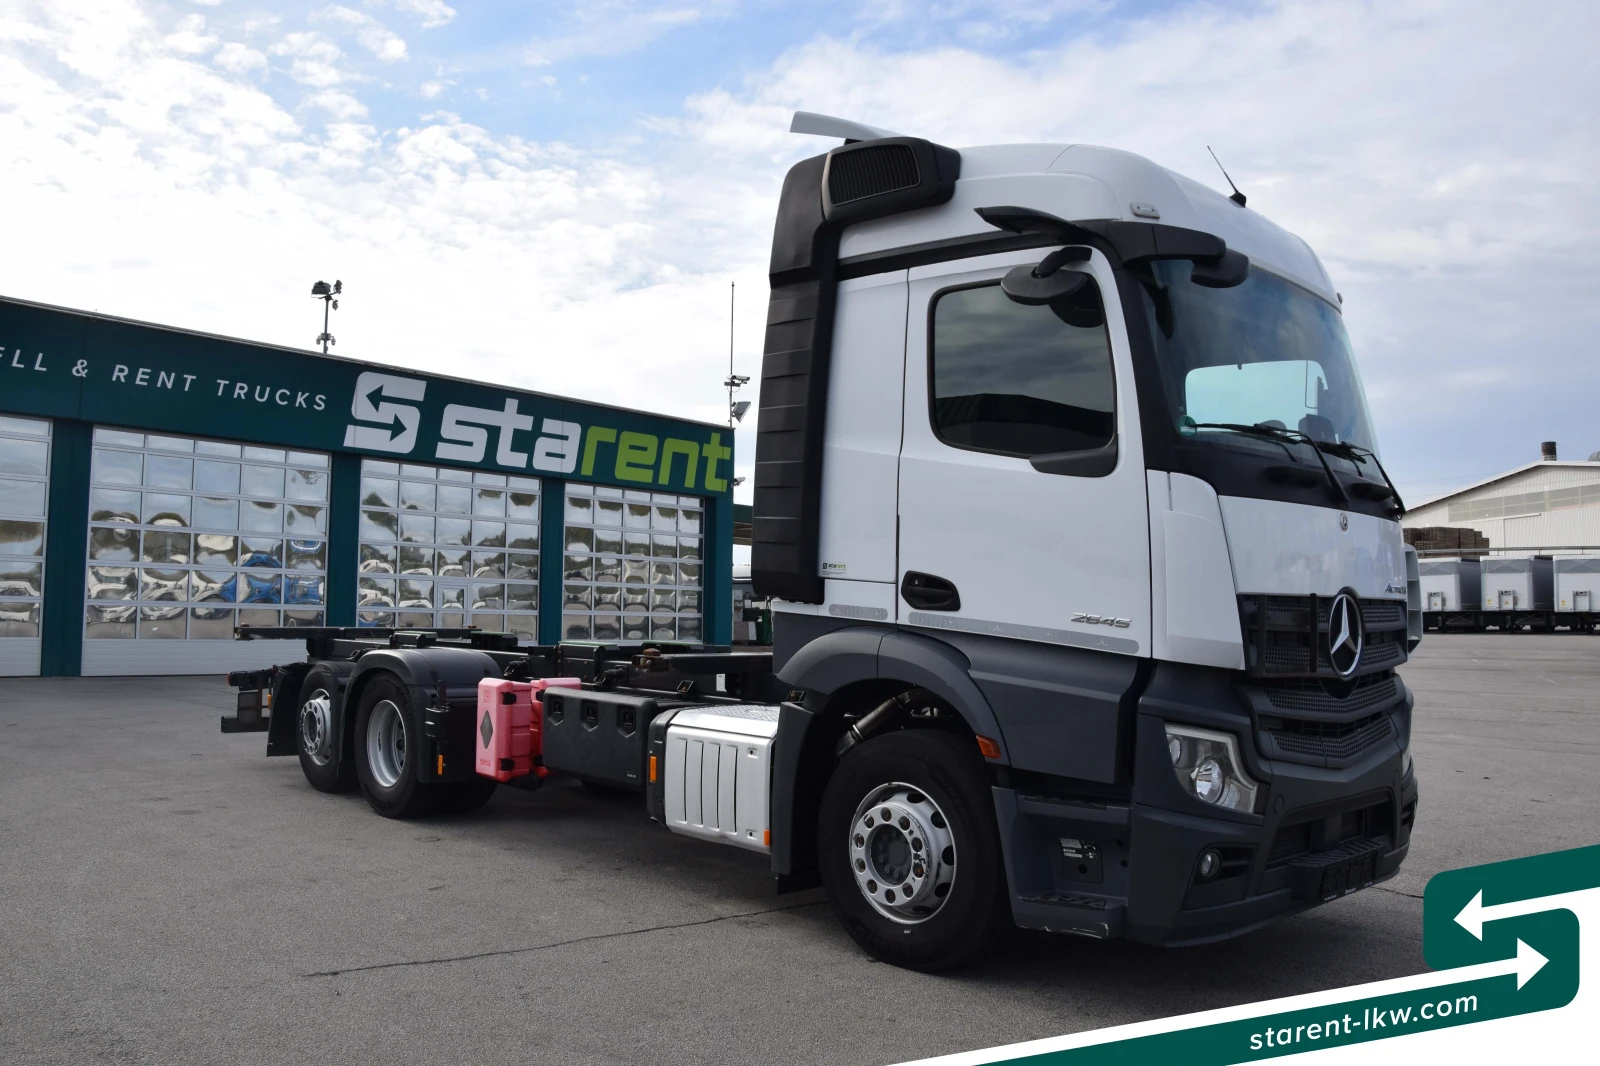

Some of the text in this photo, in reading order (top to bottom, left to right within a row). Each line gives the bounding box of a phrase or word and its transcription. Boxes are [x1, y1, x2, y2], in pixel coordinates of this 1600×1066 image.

[71, 359, 88, 378] &
[112, 364, 197, 392] RENT
[216, 379, 327, 410] TRUCKS
[435, 398, 731, 492] starent
[1070, 612, 1131, 628] 2645
